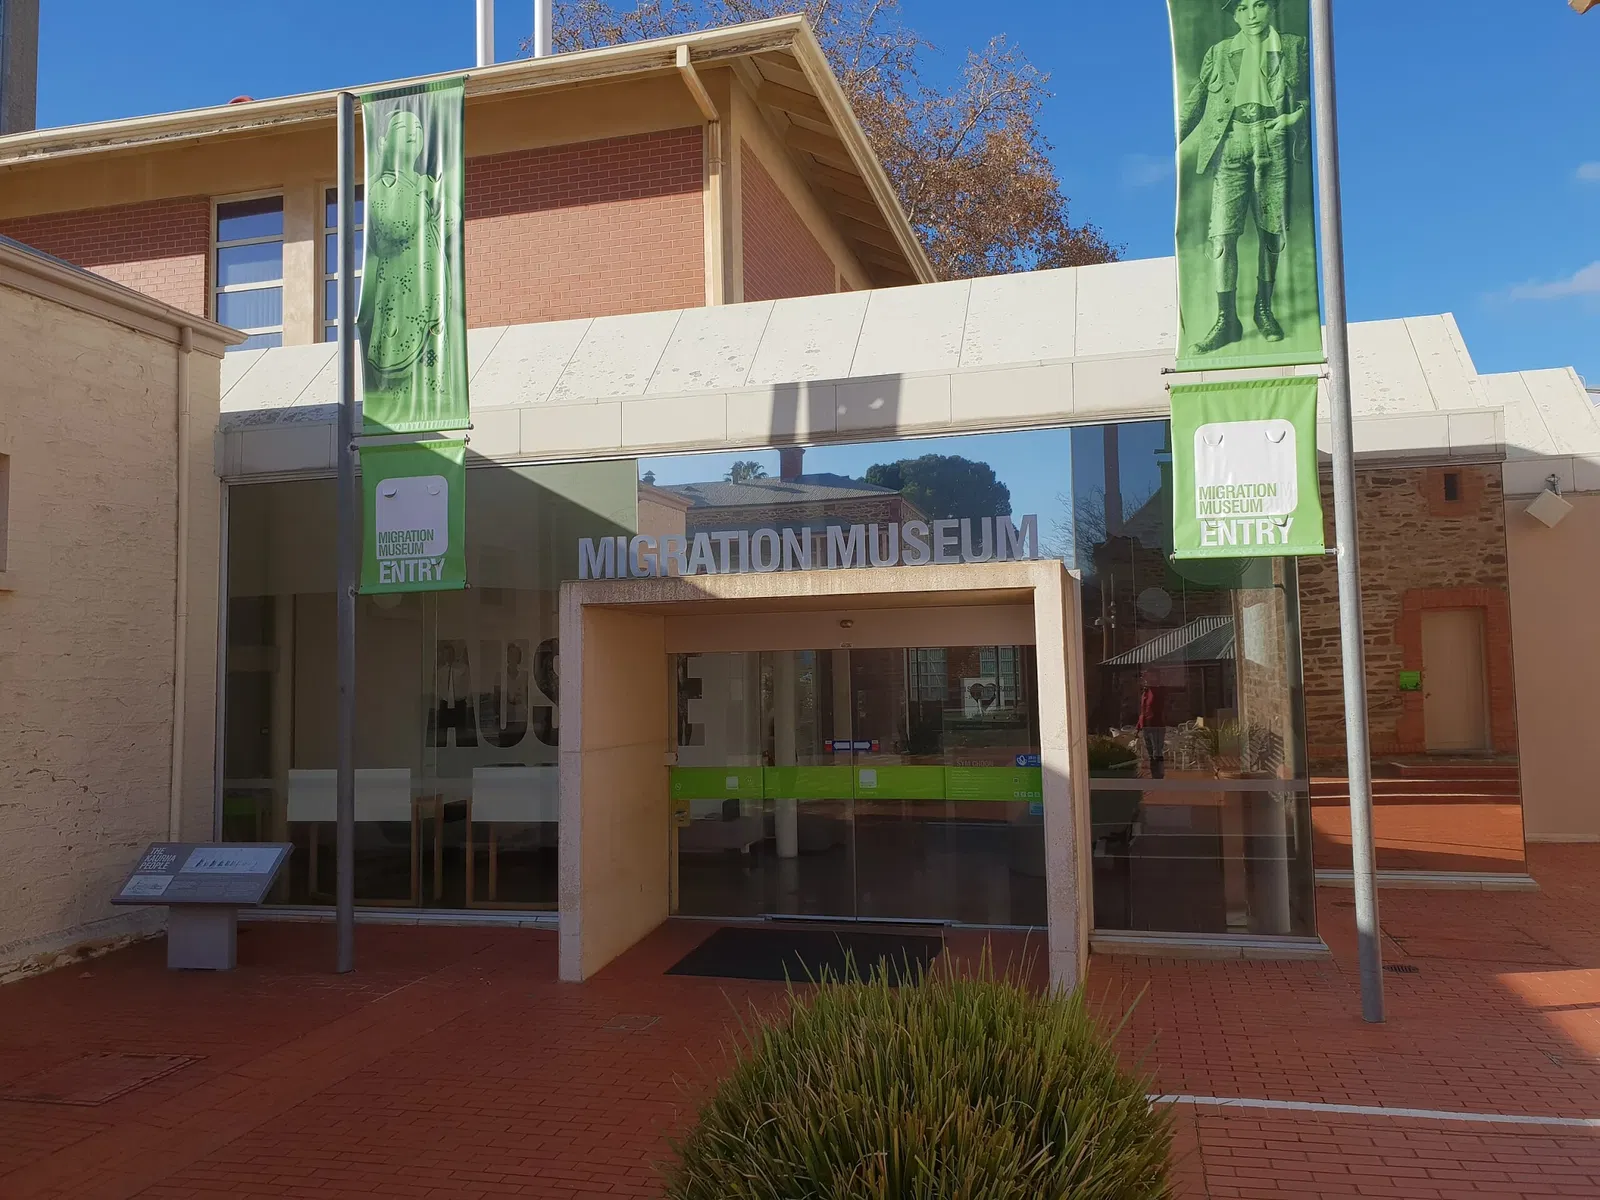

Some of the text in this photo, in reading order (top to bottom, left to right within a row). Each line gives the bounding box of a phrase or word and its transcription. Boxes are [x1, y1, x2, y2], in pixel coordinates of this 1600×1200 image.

[1199, 482, 1277, 500] MIGRATION
[1199, 499, 1263, 515] MUSEUM
[378, 529, 434, 543] MIGRATION
[1200, 517, 1294, 547] ENTRY
[378, 542, 424, 557] MUSEUM
[578, 514, 1038, 580] MIGRATION MUSEUM
[379, 558, 446, 584] ENTRY
[150, 847, 167, 855] THE
[139, 862, 171, 870] PEOPLE
